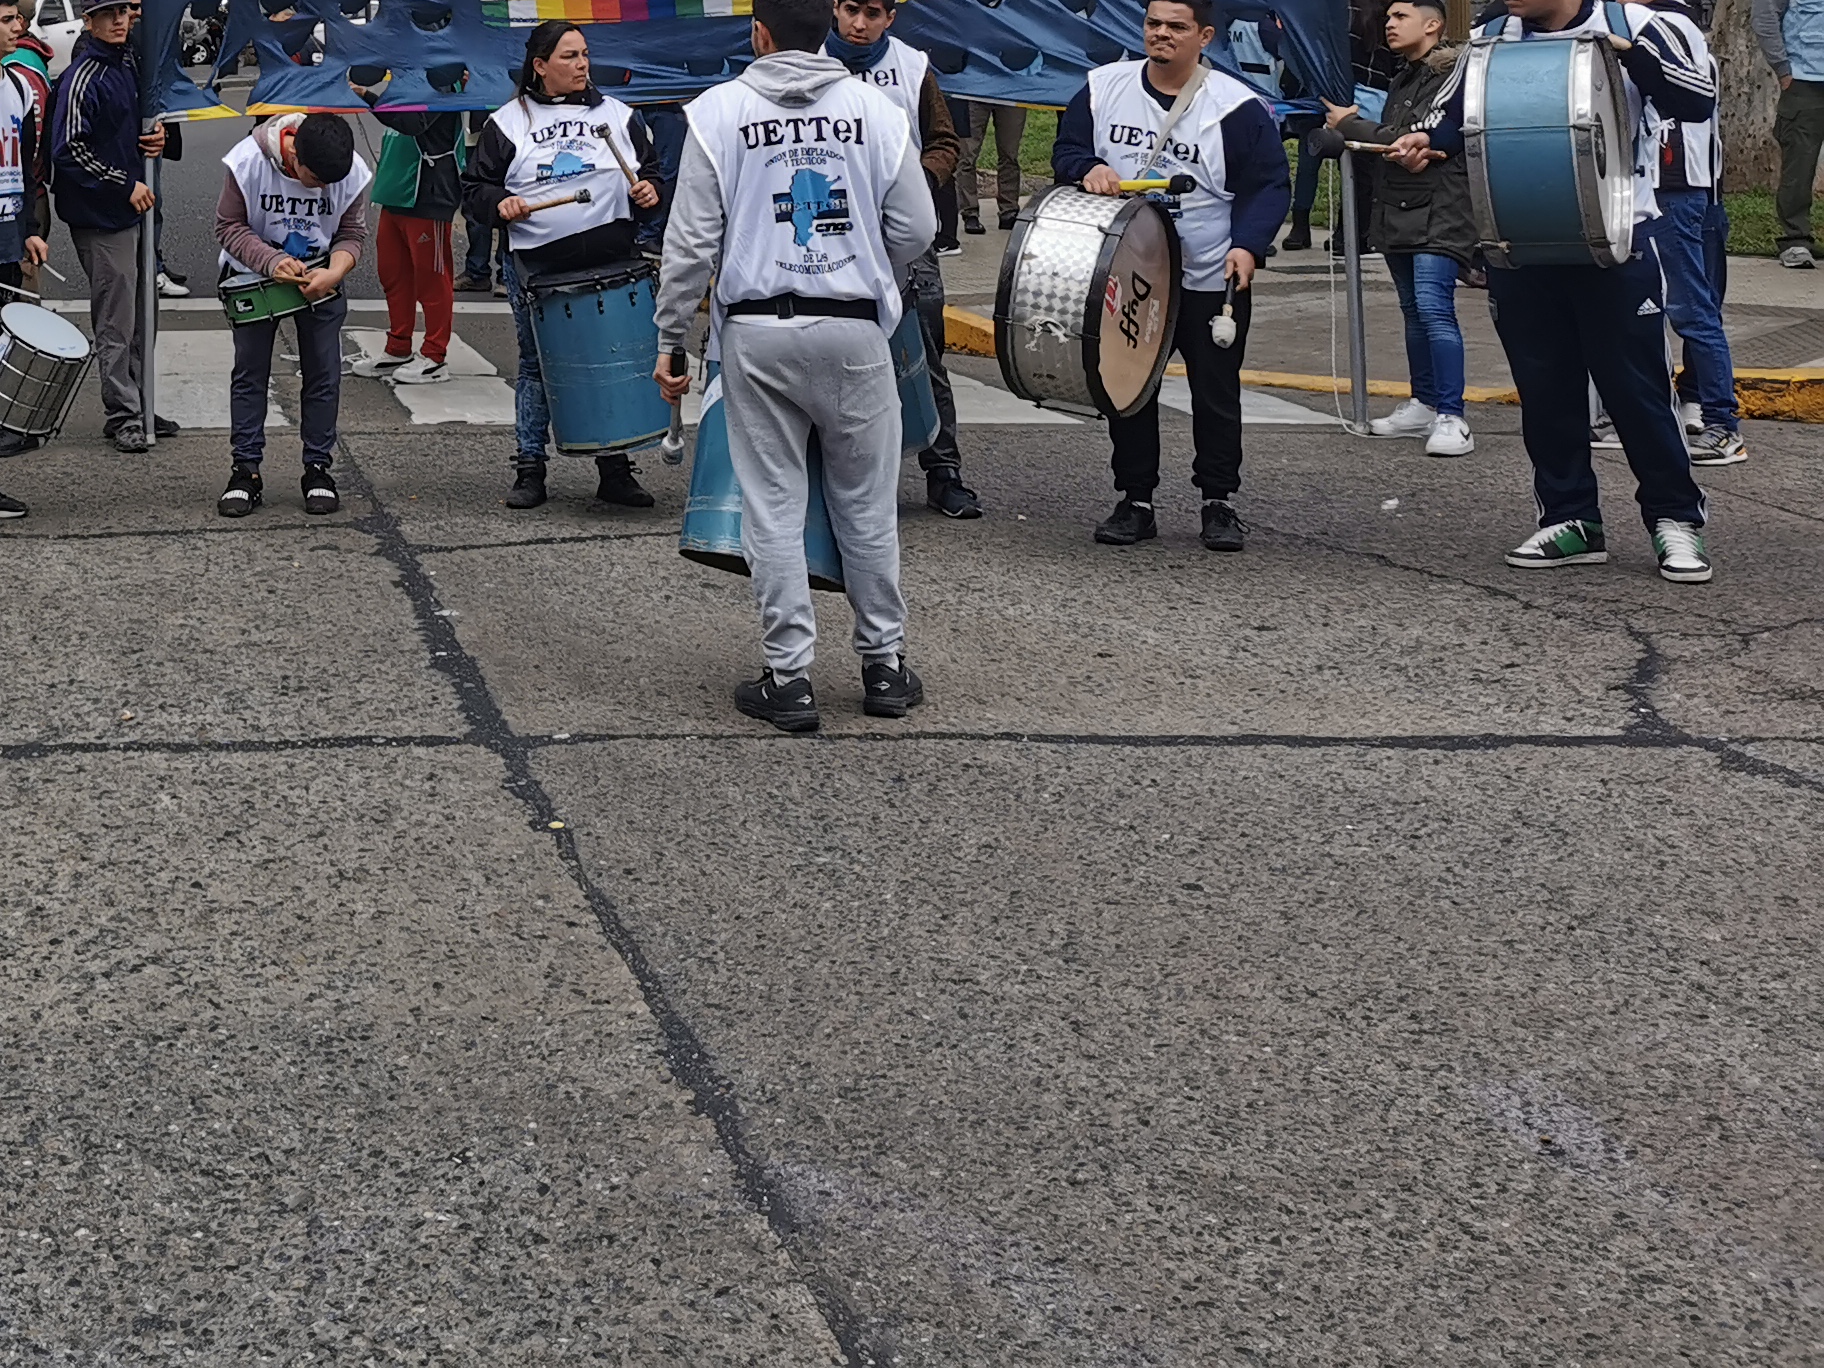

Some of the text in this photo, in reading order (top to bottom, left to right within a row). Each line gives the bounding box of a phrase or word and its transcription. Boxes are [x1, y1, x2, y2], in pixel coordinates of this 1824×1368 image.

[860, 68, 899, 87] Tel
[530, 121, 600, 143] UETTe
[739, 117, 864, 149] UETTel
[788, 149, 799, 158] DE
[804, 254, 814, 263] DE
